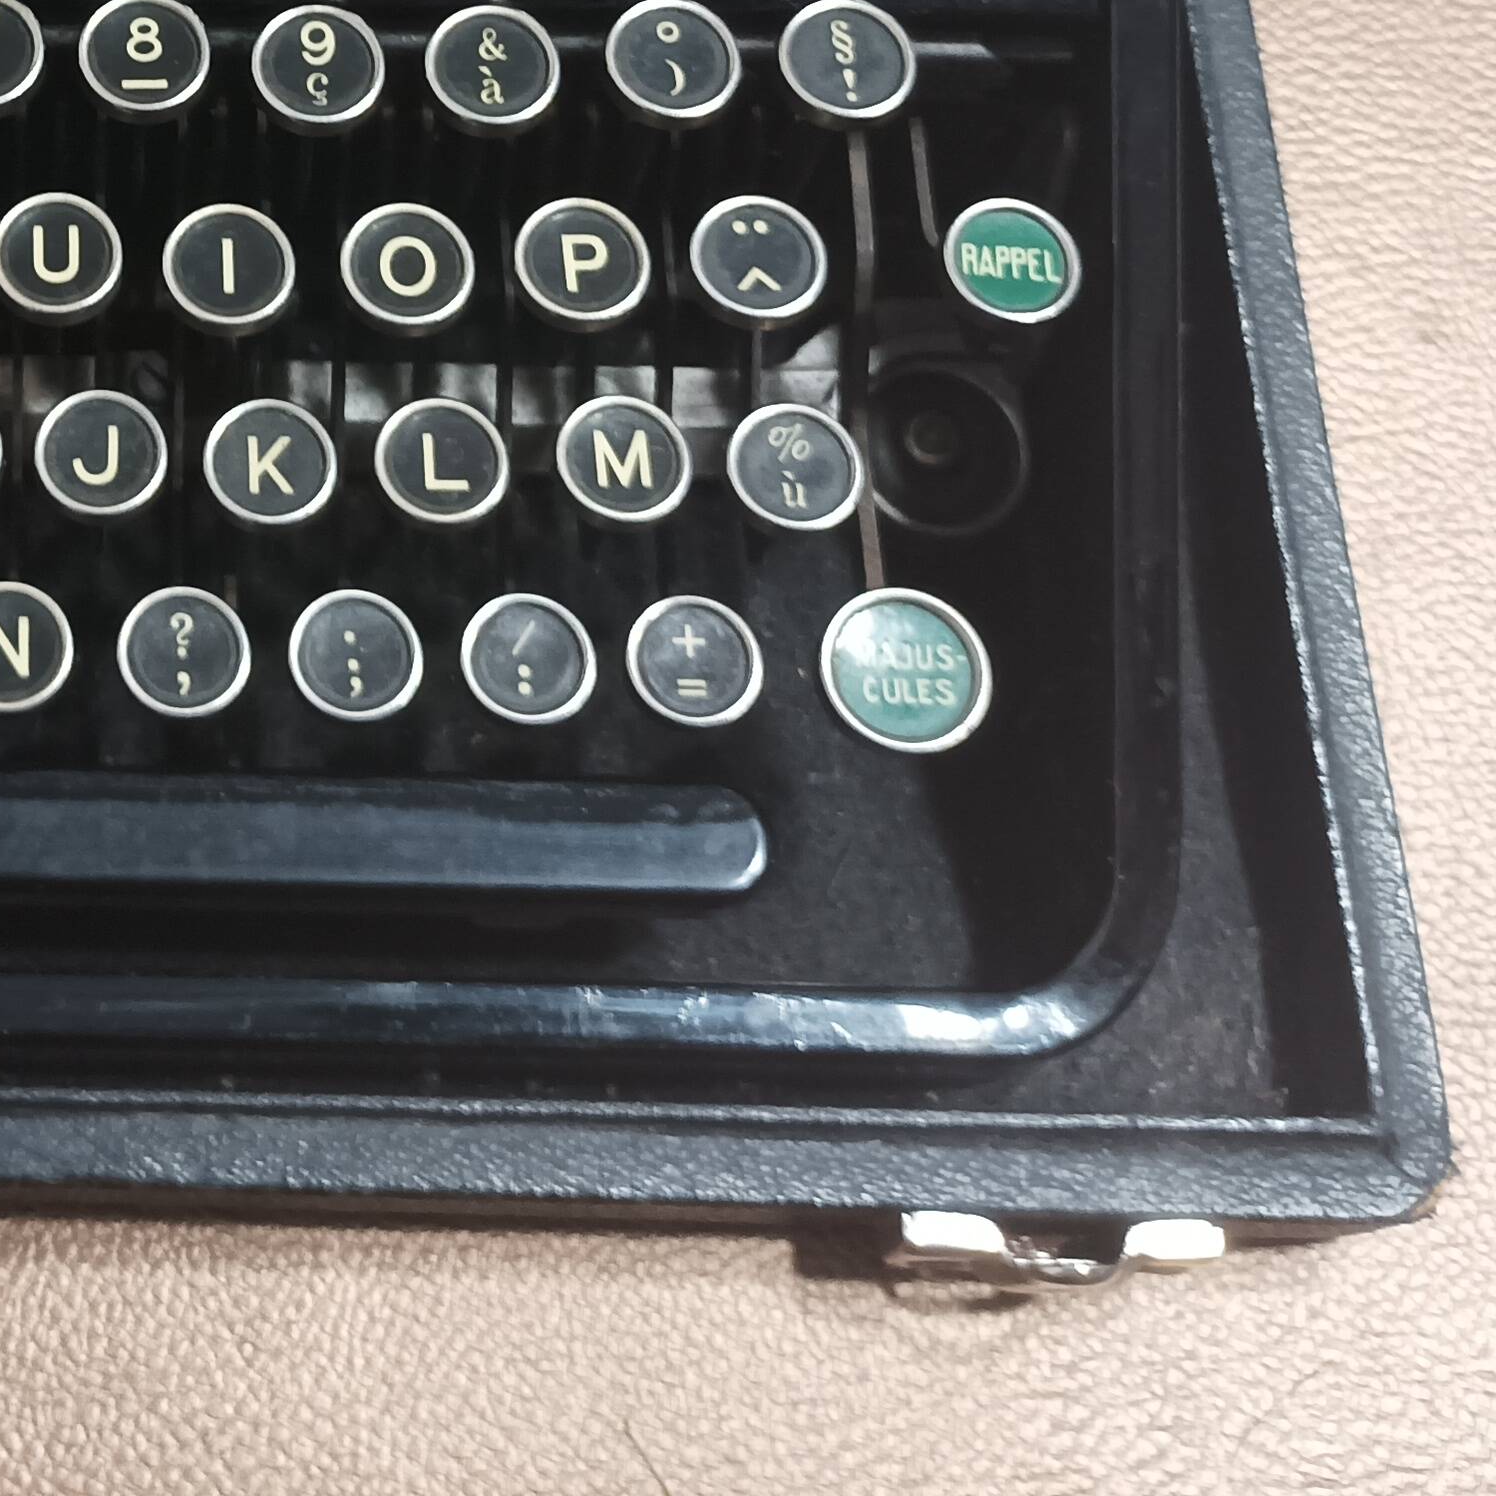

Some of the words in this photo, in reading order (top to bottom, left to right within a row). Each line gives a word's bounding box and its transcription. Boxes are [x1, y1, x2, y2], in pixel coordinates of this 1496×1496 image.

[126, 16, 163, 63] 8
[300, 20, 336, 66] 9
[478, 27, 508, 61] &
[830, 20, 855, 65] §
[478, 66, 505, 105] à
[665, 59, 685, 97] )
[842, 68, 858, 103] !
[32, 224, 80, 284] U
[221, 237, 235, 294] I
[379, 235, 437, 297] O
[560, 233, 609, 293] P
[960, 244, 1063, 285] RAPPEL
[72, 424, 119, 486] J
[247, 435, 294, 495] K
[422, 432, 470, 492] L
[592, 428, 653, 488] M
[767, 423, 810, 462] %
[169, 612, 194, 659] ?
[671, 623, 706, 659] +
[863, 677, 957, 705] CULES
